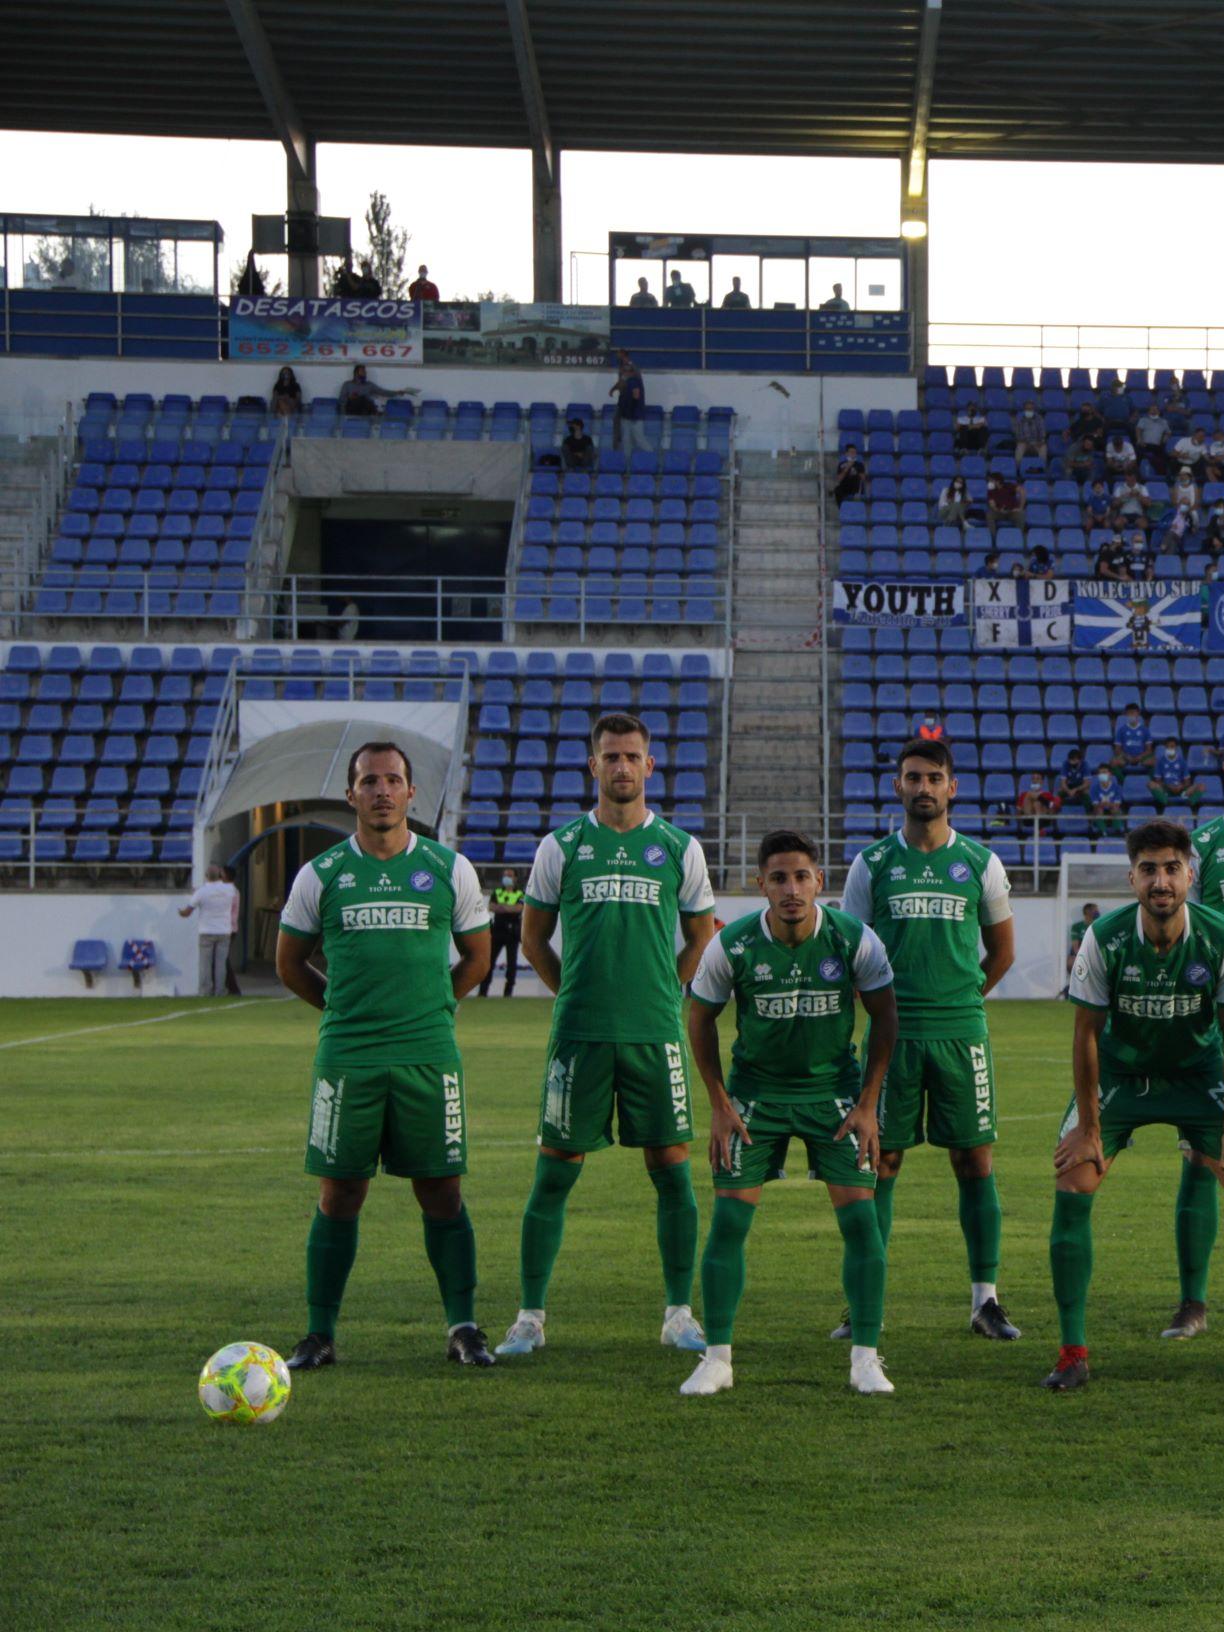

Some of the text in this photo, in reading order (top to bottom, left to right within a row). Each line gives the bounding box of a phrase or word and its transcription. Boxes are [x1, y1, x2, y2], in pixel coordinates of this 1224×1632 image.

[235, 299, 415, 319] DESATASCOS
[238, 341, 413, 358] 652 261 667
[544, 355, 605, 365] 652 261 667
[842, 583, 956, 616] YOUTH
[988, 580, 1057, 602] X D
[1076, 580, 1166, 599] KOLECTIVO
[992, 621, 1058, 643] F C
[581, 880, 661, 904] RANABE
[342, 907, 430, 929] RANABE
[888, 898, 967, 919] RANABE
[755, 994, 840, 1018] RANABE
[664, 1041, 688, 1115] XEREZ
[969, 1043, 991, 1115] XEREZ
[442, 1071, 463, 1146] XEREZ
